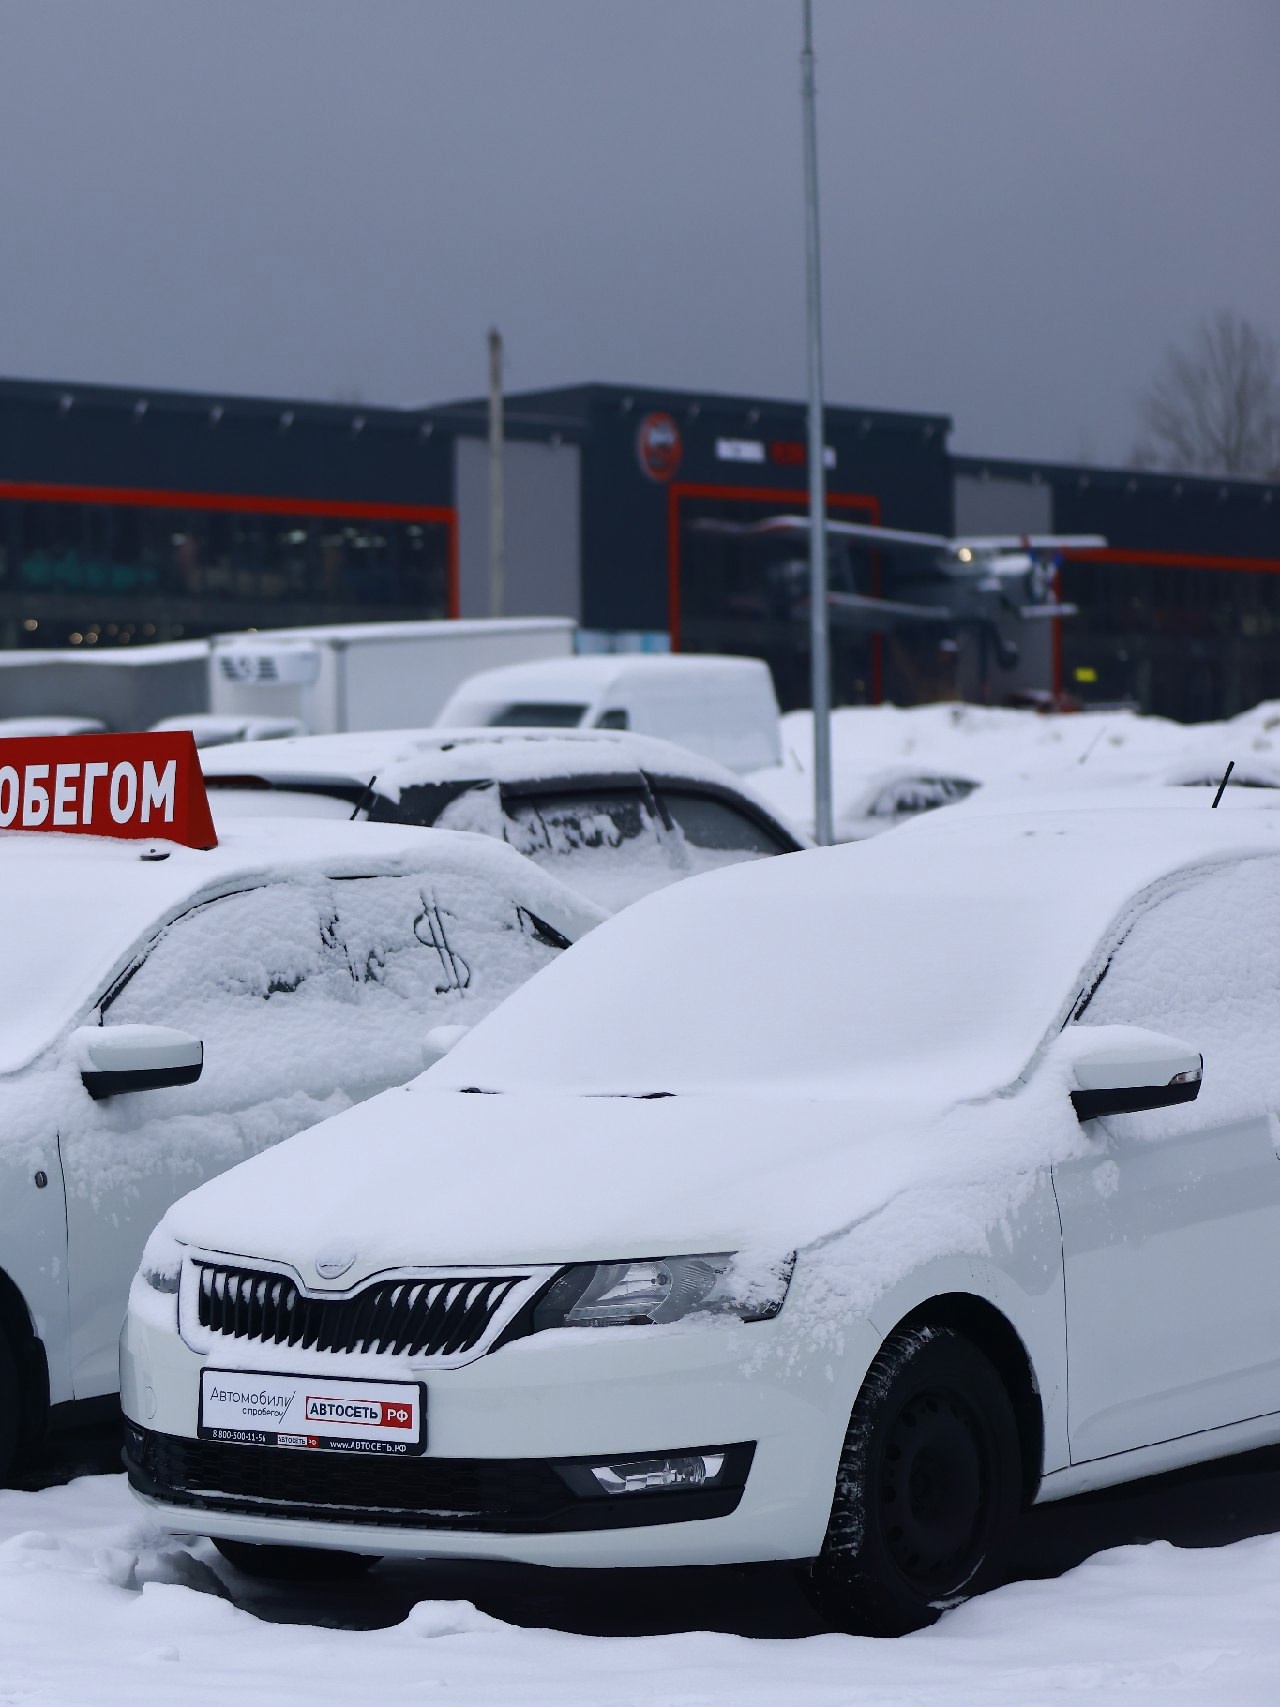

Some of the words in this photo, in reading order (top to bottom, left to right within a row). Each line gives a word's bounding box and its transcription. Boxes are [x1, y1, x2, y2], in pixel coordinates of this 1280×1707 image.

[210, 1386, 293, 1408] Автомобили
[309, 1402, 379, 1419] АВТОСЕТЬ
[387, 1408, 409, 1423] РФ
